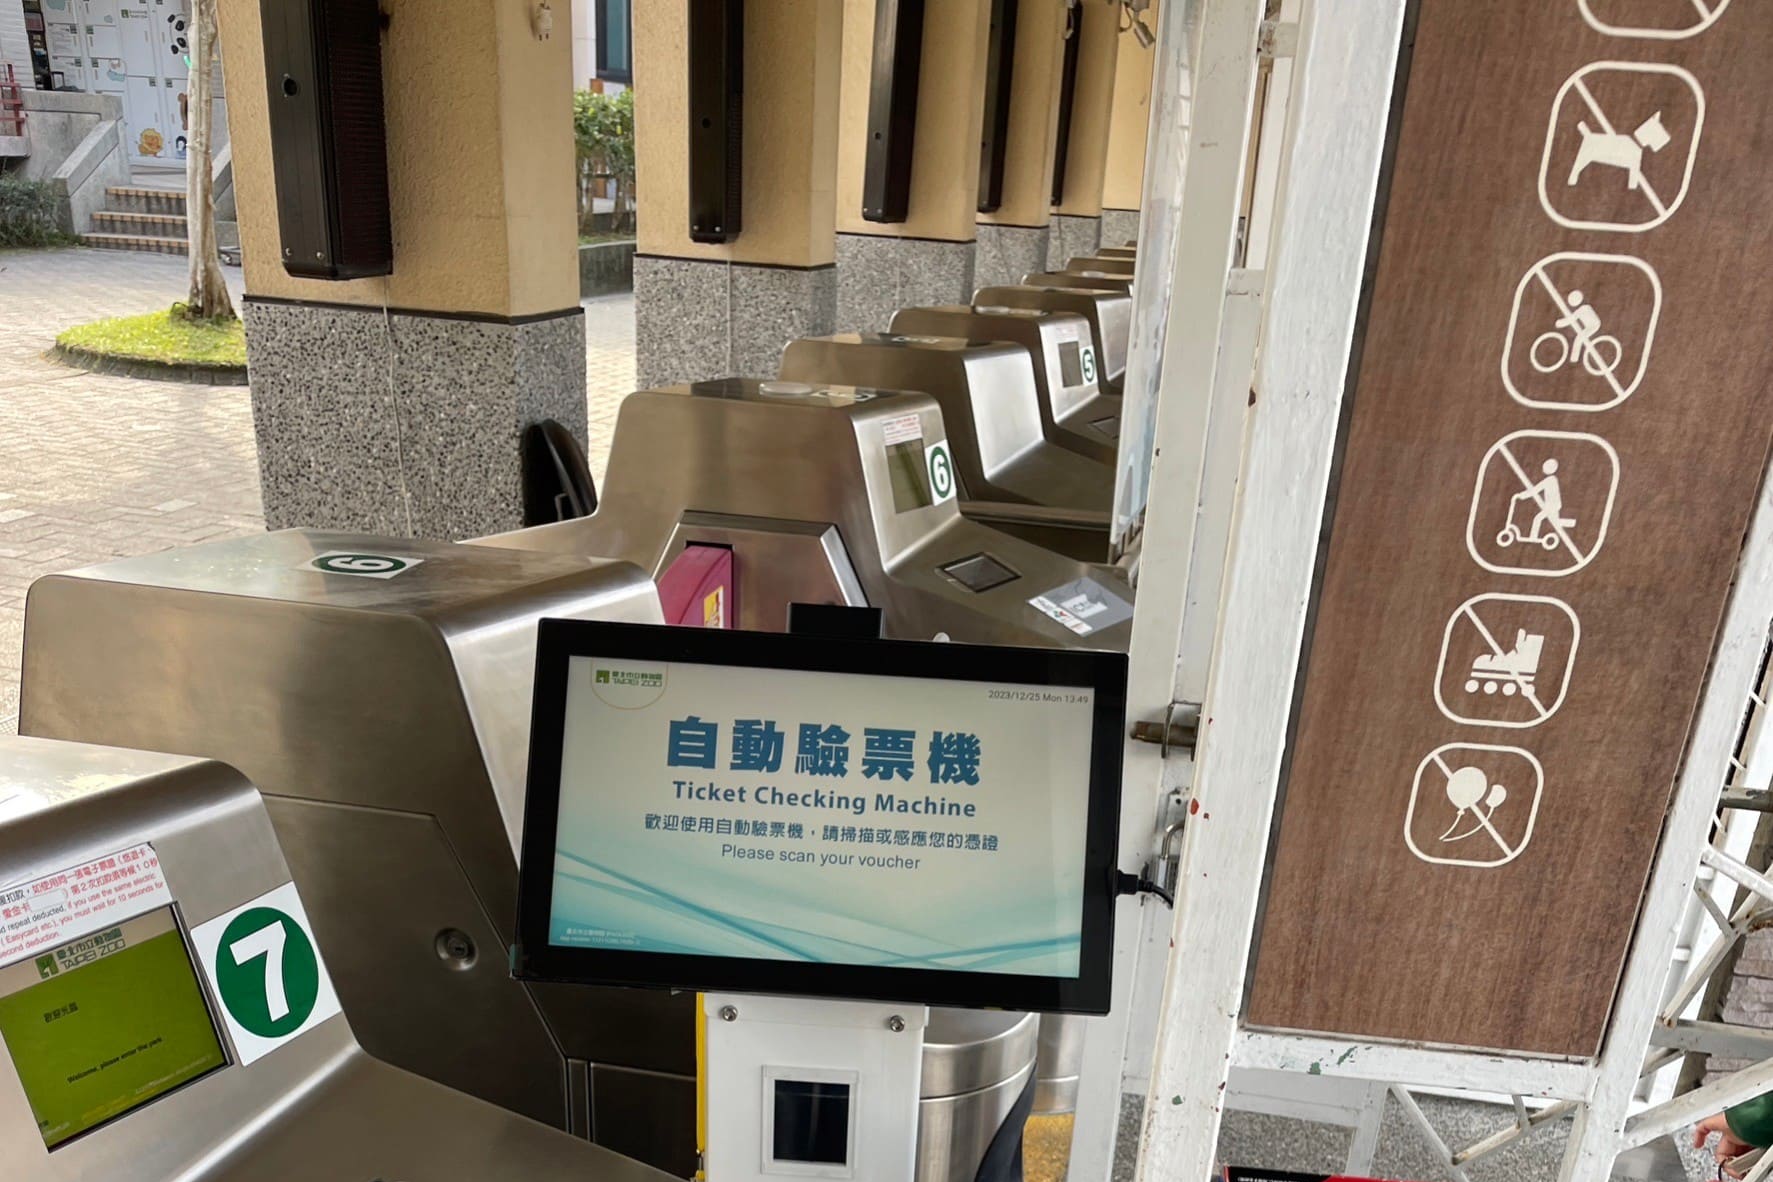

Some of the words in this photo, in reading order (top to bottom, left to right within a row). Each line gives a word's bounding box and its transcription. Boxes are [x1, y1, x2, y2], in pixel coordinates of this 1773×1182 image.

[933, 454, 949, 492] 6
[1043, 693, 1062, 703] Mon
[667, 715, 982, 786] 自動驗票機
[672, 780, 747, 803] Ticket
[754, 786, 866, 815] Checking
[875, 793, 976, 817] Machine
[722, 844, 775, 861] Please
[779, 849, 816, 863] scan
[820, 854, 855, 869] your
[858, 853, 921, 870] voucher
[8, 915, 31, 931] repeat
[73, 898, 87, 910] you
[87, 893, 100, 904] use
[101, 887, 113, 899] the
[114, 881, 132, 893] same
[60, 914, 73, 926] you
[74, 907, 91, 919] must
[93, 902, 106, 913] wait
[107, 896, 116, 907] for
[118, 893, 127, 903] 10
[128, 886, 154, 899] seconds
[154, 881, 164, 890] for
[229, 919, 290, 1023] 7
[100, 1056, 120, 1070] please
[121, 1048, 137, 1060] enter
[137, 1043, 149, 1054] the
